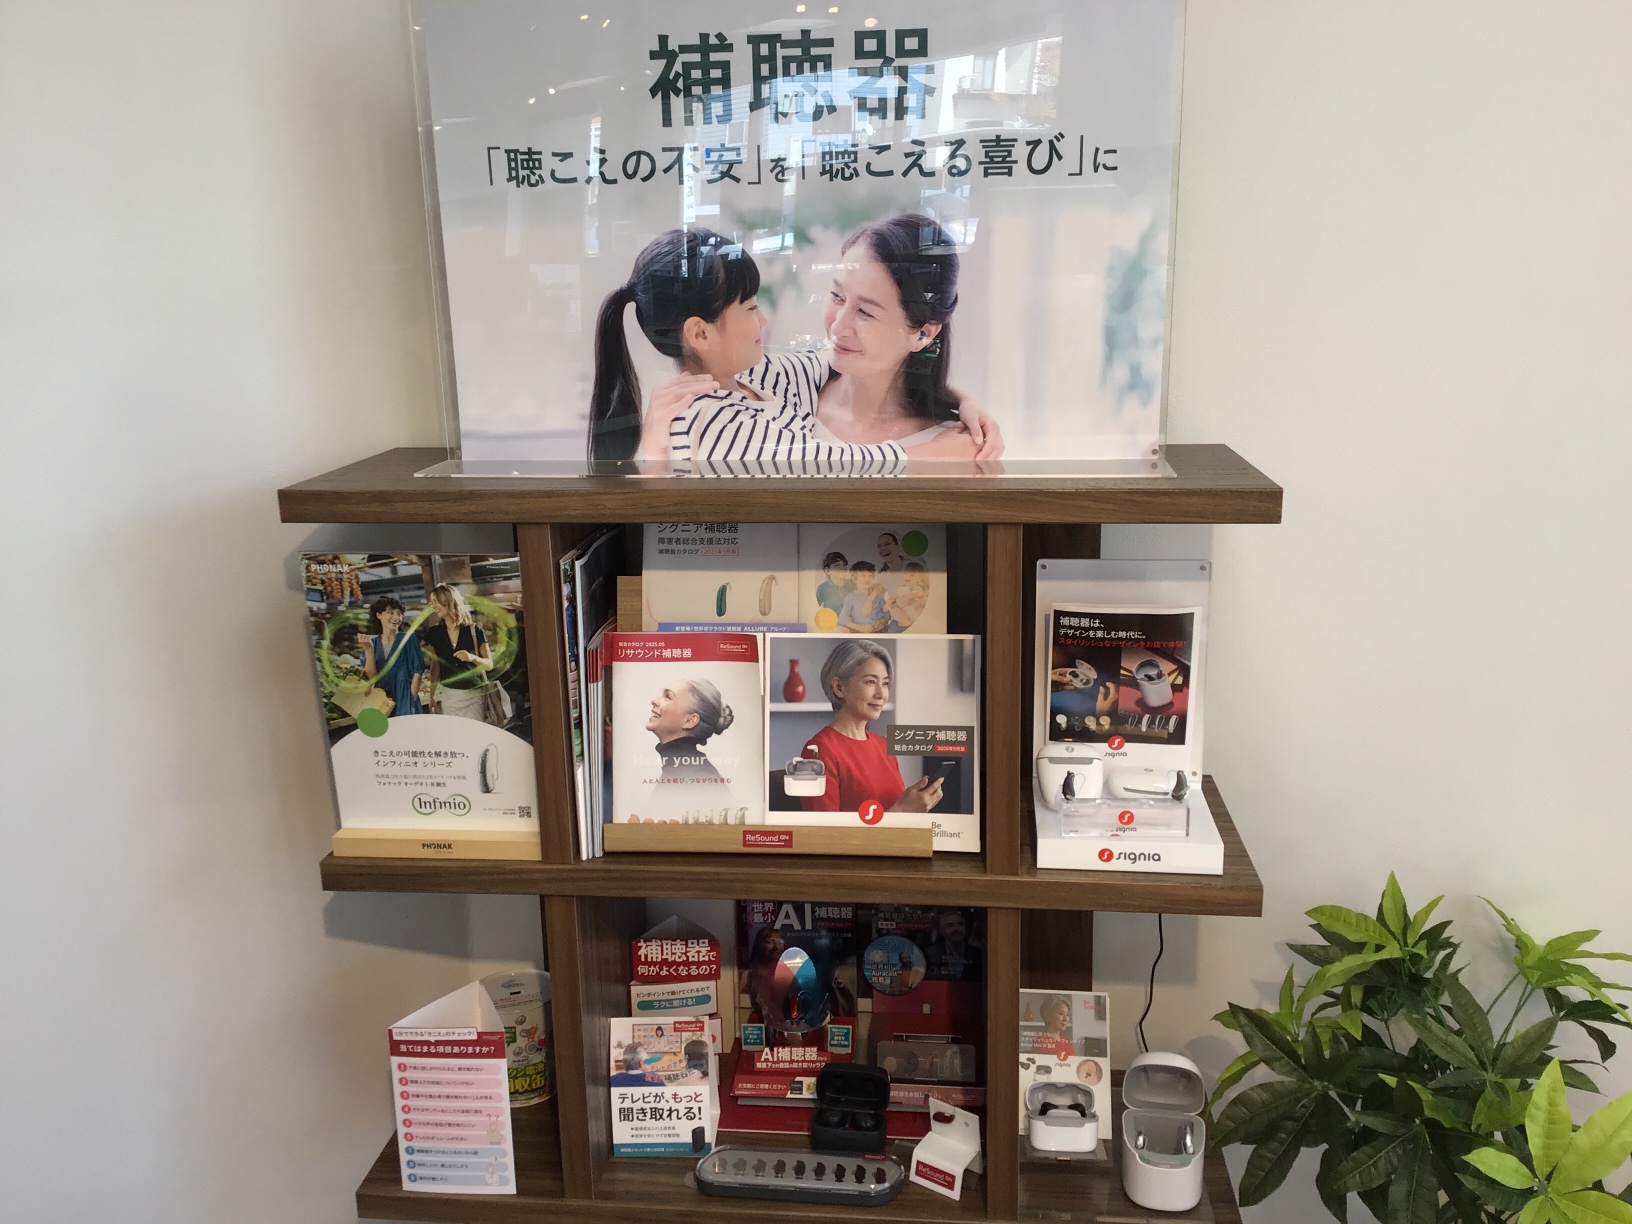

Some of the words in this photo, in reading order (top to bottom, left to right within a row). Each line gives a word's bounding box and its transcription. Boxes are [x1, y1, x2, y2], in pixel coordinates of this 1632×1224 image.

[649, 28, 936, 127] 補聴器
[486, 131, 1119, 188] 「聴こえの不安」を「聴こえる喜び」に
[657, 537, 739, 546] 障害者総合支援法対応
[310, 564, 350, 573] PHONAK
[1059, 616, 1105, 628] 補聴器は、
[1059, 628, 1147, 639] デザインを楽しむ時代に。
[618, 648, 693, 658] リサウンド補聴器
[894, 729, 968, 741] シグニア補聴器
[894, 744, 933, 752] 総合カタログ
[373, 750, 469, 759] きこえの可能性を解き放つ。
[374, 760, 419, 768] インフィニオ
[422, 761, 453, 769] シリーズ
[673, 756, 708, 768] your
[417, 797, 466, 811] Infinio
[931, 821, 942, 830] Be
[746, 834, 778, 842] ReSound
[1116, 852, 1161, 864] signia
[752, 902, 775, 912] 世界
[753, 913, 776, 923] 最小
[773, 903, 813, 930] AI
[814, 907, 853, 919] 補聴器
[637, 939, 717, 962] 補聴器で
[637, 965, 717, 976] 何がよくなるの?
[653, 998, 696, 1009] ラクに聞ける!
[400, 1044, 495, 1054] 当てはまる項目ありますか?
[618, 1092, 703, 1105] テレビが、もっと
[618, 1106, 703, 1122] 聞き取れる!
[918, 1164, 944, 1180] ReSound
